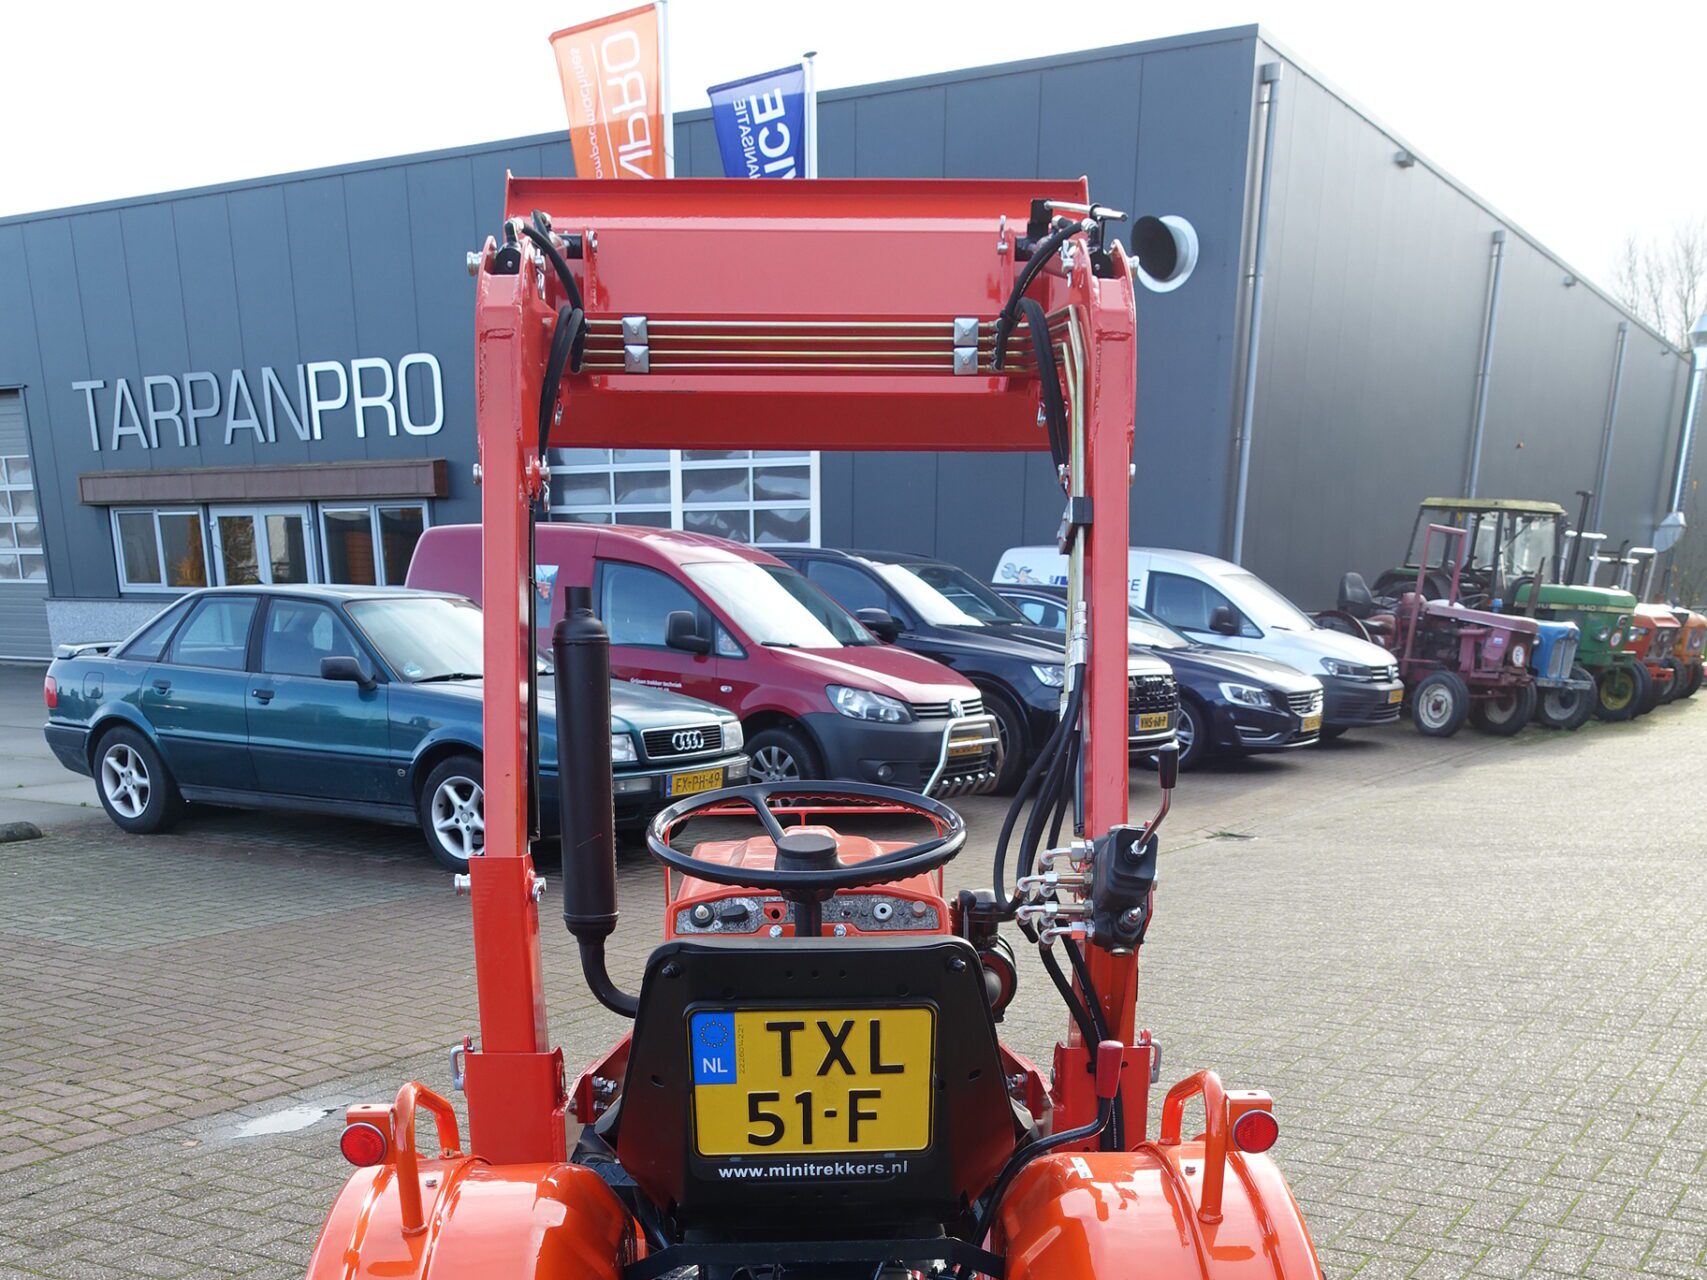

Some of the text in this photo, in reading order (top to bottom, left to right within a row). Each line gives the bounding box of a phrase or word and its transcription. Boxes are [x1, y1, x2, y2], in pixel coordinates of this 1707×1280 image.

[72, 352, 445, 451] TARPANPRO
[702, 1057, 728, 1074] NL
[765, 1019, 905, 1077] TXL
[747, 1088, 882, 1146] 51-F
[718, 1159, 909, 1178] www.minitrekkers.nl
